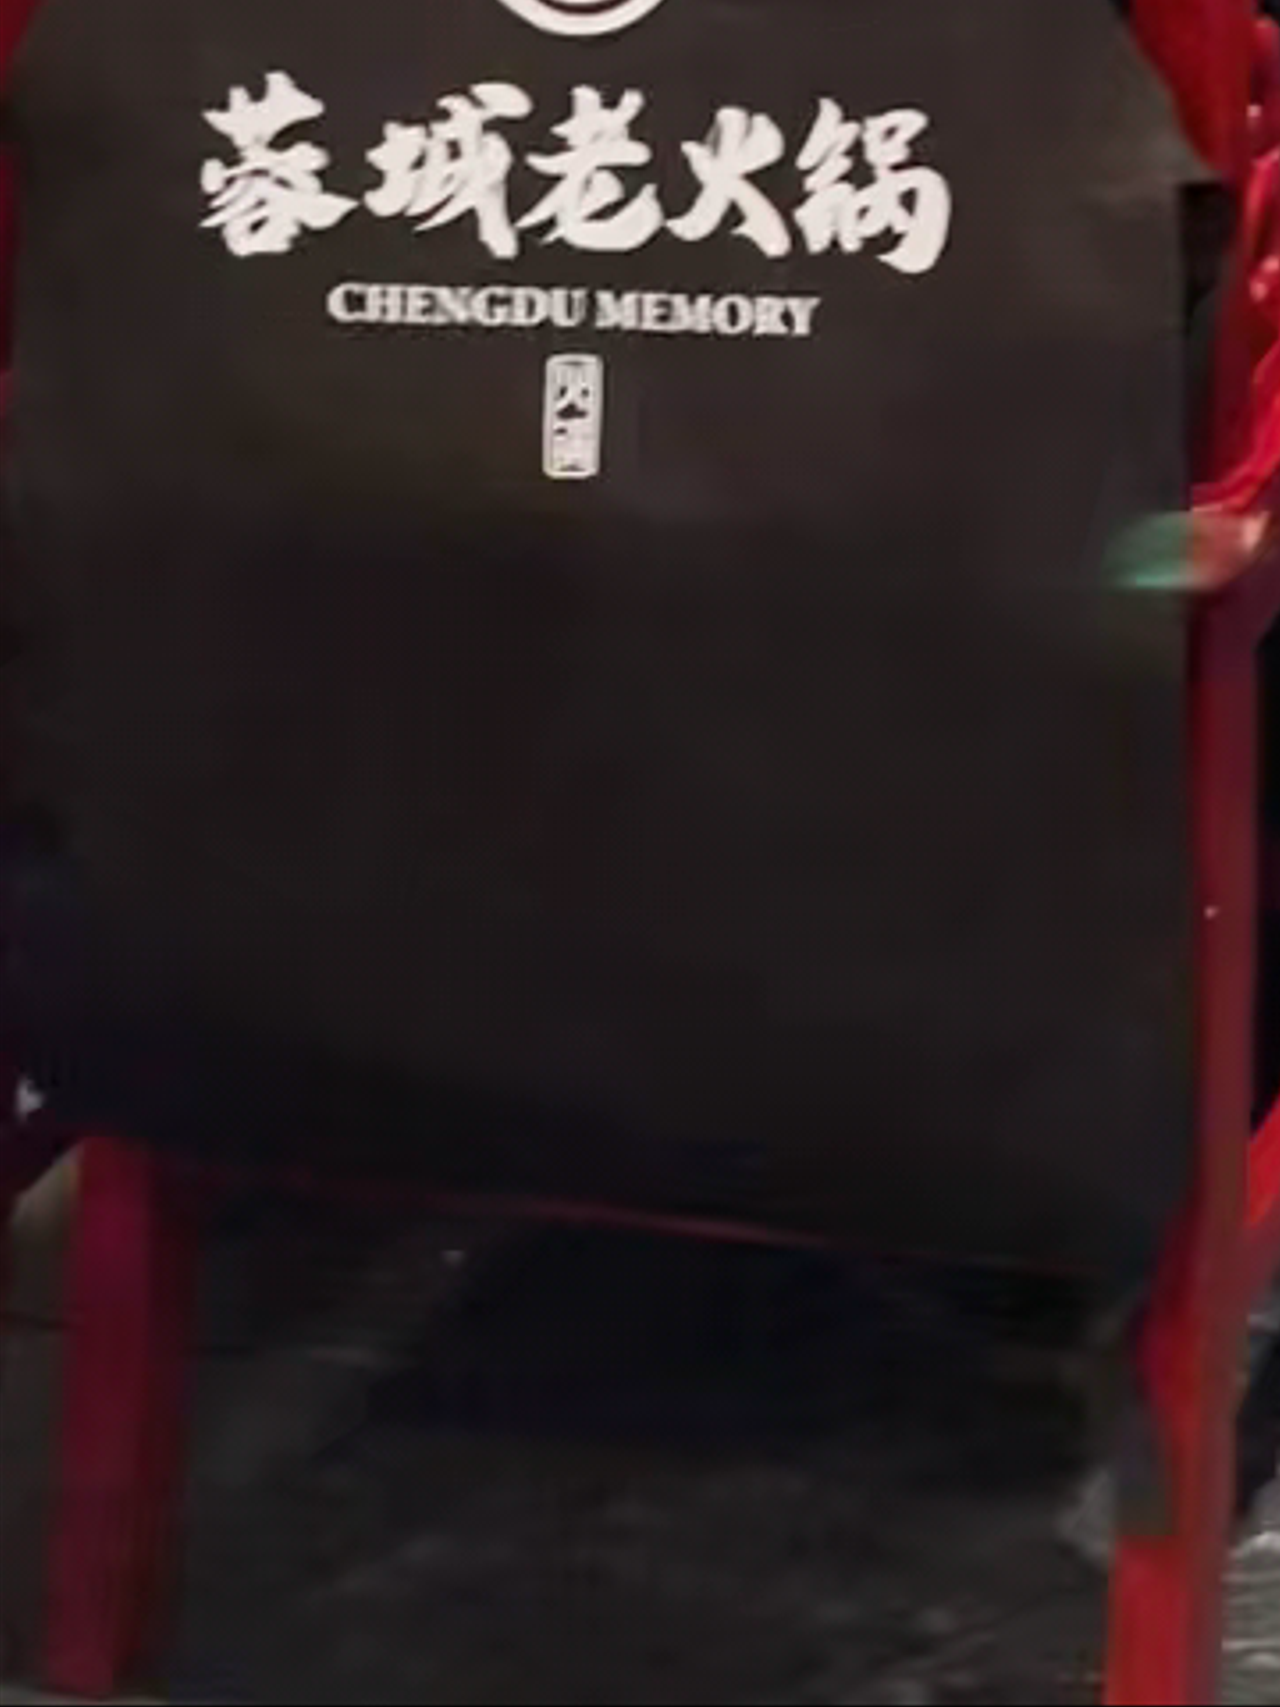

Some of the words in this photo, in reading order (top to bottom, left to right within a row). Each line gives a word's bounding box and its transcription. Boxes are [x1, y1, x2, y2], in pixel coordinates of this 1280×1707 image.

[200, 71, 951, 274] 蓉城老火锅
[327, 282, 587, 328] CHENGDU
[595, 289, 820, 336] MEMORY
